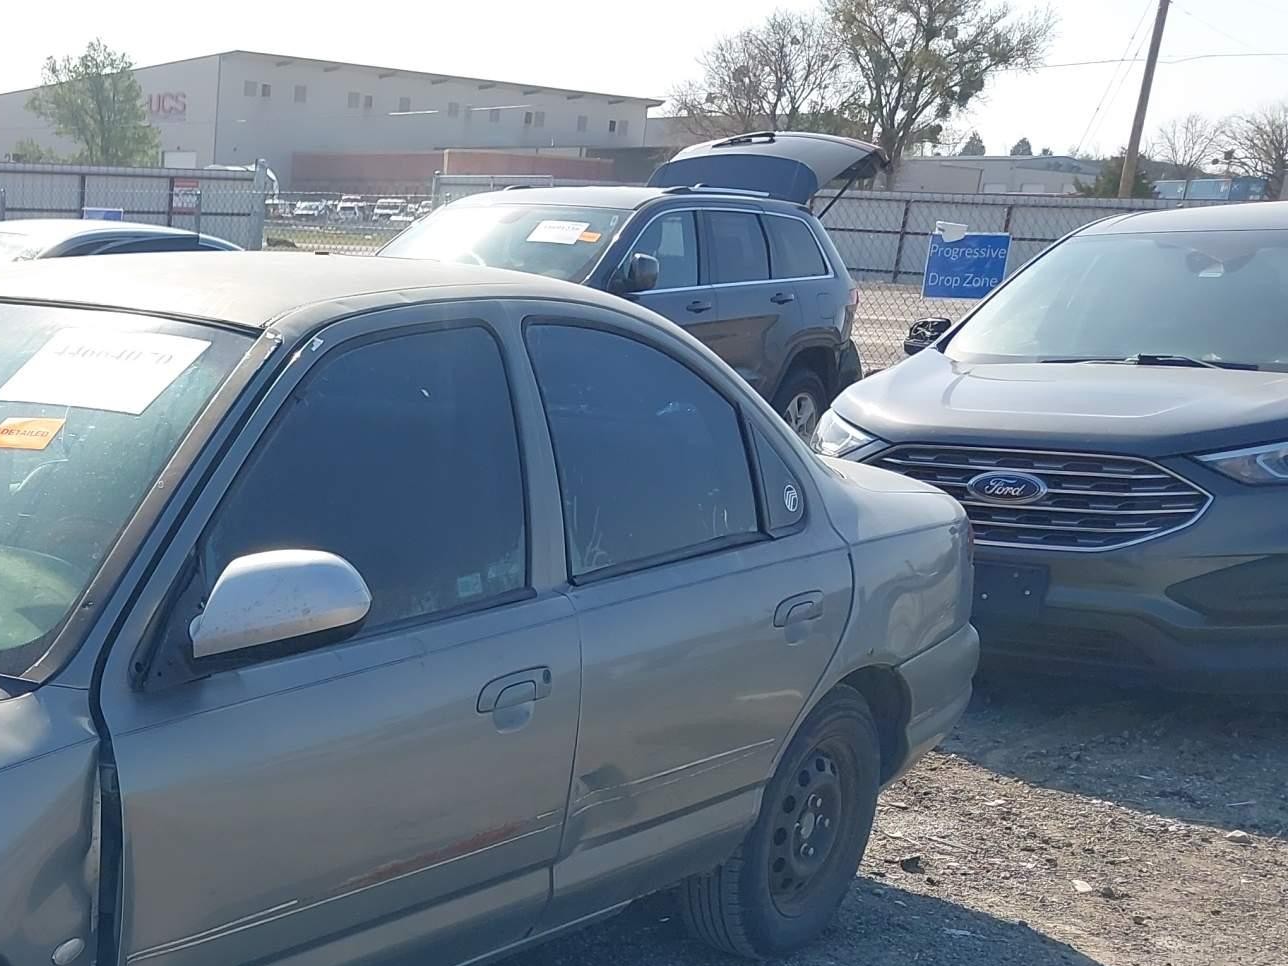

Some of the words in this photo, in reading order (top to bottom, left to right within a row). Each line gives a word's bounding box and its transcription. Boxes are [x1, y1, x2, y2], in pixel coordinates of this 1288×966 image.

[929, 243, 1007, 261] Progressive
[928, 272, 961, 289] Drop
[963, 273, 998, 288] Zone
[0, 427, 49, 438] DETAILED
[984, 477, 1026, 497] Ford
